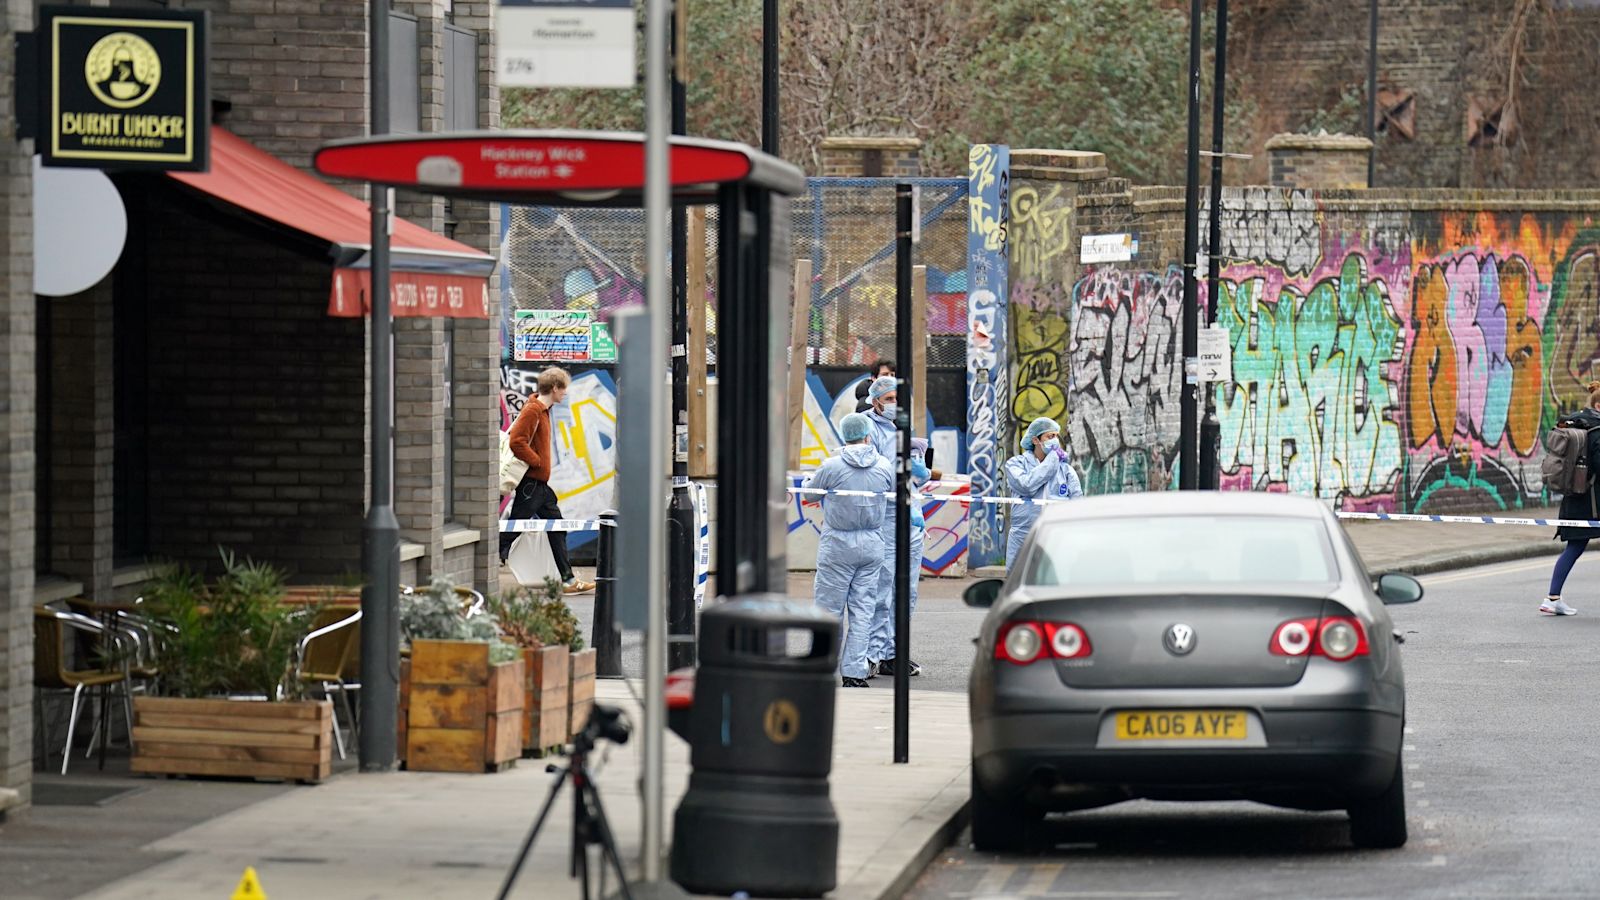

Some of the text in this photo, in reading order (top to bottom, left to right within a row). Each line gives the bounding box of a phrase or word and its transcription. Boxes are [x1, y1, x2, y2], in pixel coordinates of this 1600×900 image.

[62, 112, 184, 138] BURNT UMBER
[481, 145, 586, 163] Hackney Wick
[495, 162, 550, 179] Station
[1126, 714, 1237, 736] CA06 AYF
